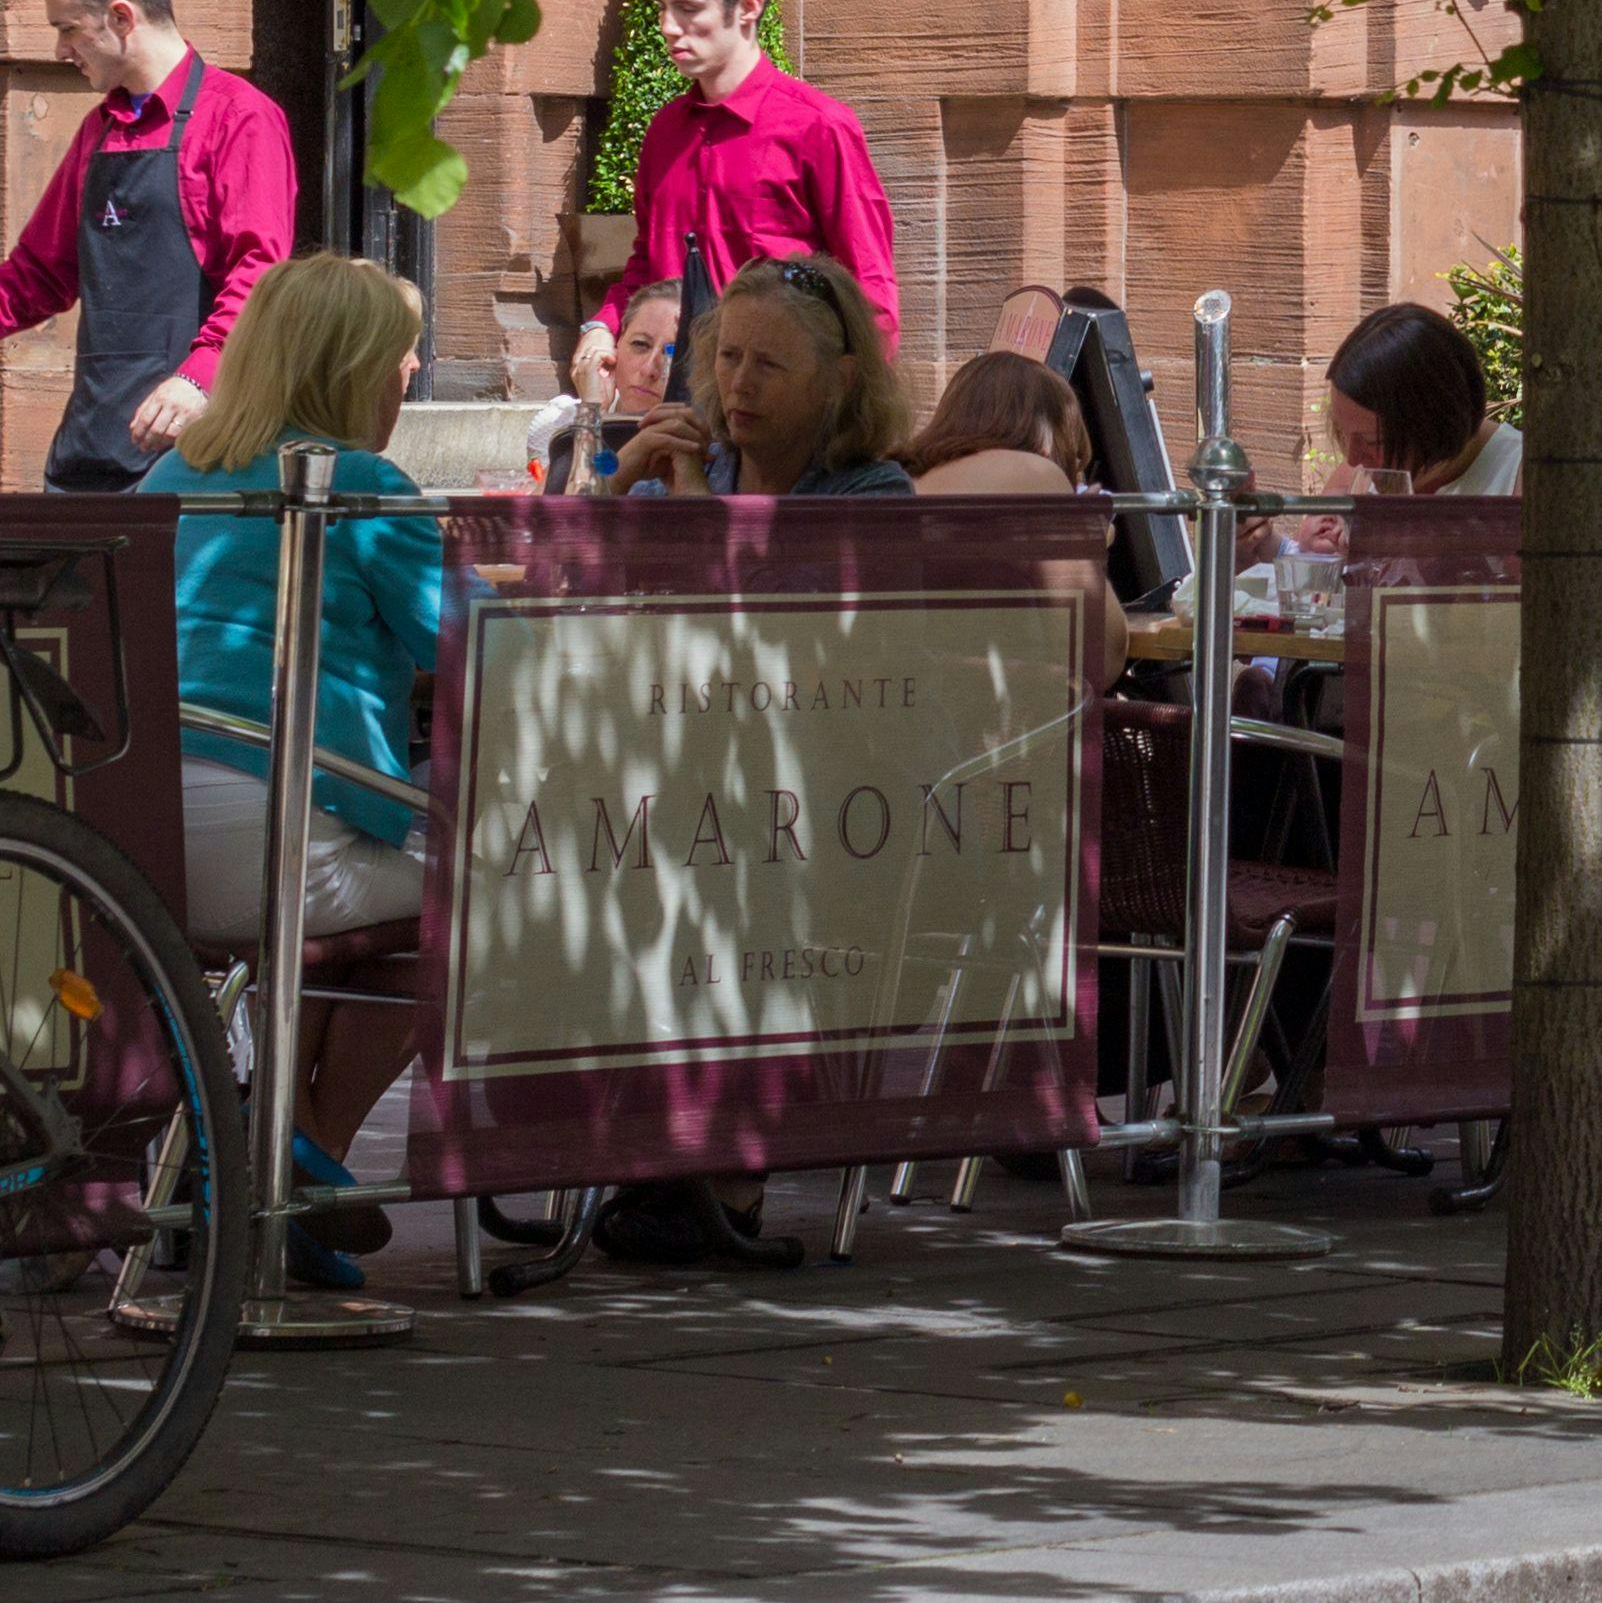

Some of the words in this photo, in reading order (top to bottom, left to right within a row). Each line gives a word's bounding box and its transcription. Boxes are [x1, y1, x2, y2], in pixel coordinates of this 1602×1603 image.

[649, 677, 917, 715] RISTORANTE
[503, 780, 1034, 878] AMARONE
[679, 954, 721, 986] AL
[742, 945, 866, 982] FRESCO
